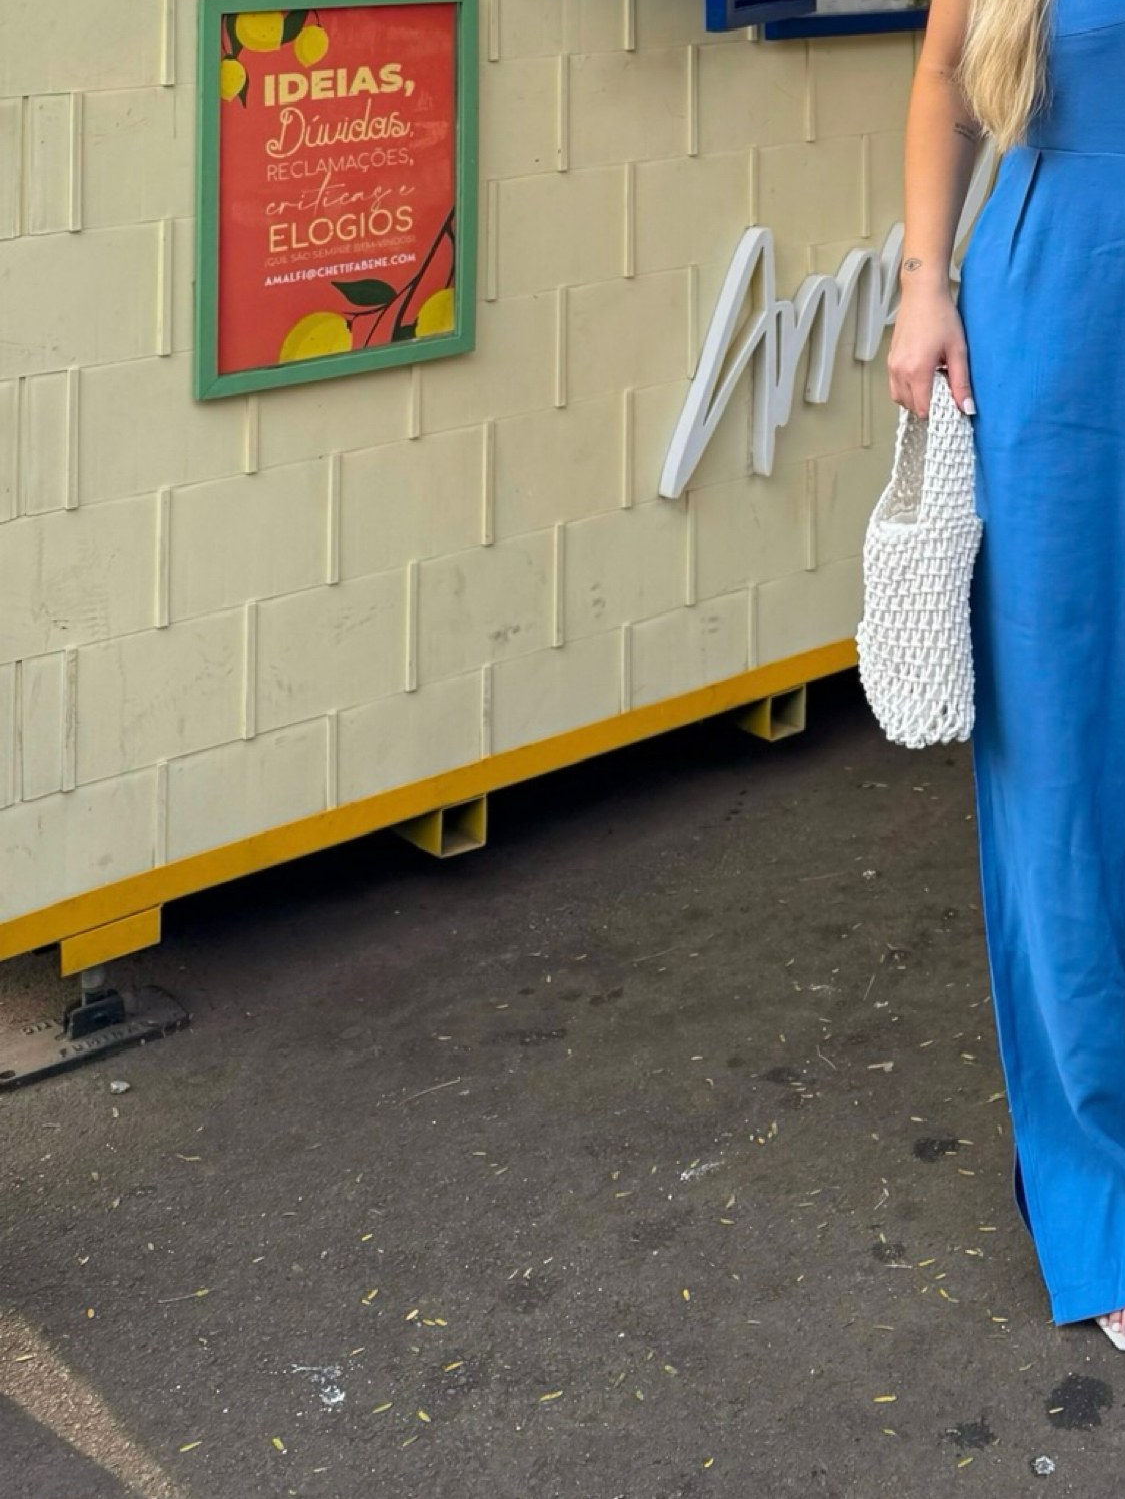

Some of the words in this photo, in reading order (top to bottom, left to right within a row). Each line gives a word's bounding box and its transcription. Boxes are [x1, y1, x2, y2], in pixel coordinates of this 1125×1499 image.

[264, 62, 415, 107] IDEIAS,
[266, 98, 414, 158] Dúvidas,
[267, 147, 414, 182] RECLAMAÇÕES,
[400, 184, 415, 196] e
[269, 205, 414, 253] ELOGIOS
[265, 253, 417, 287] AMALFI@CHETIFABENE.COM
